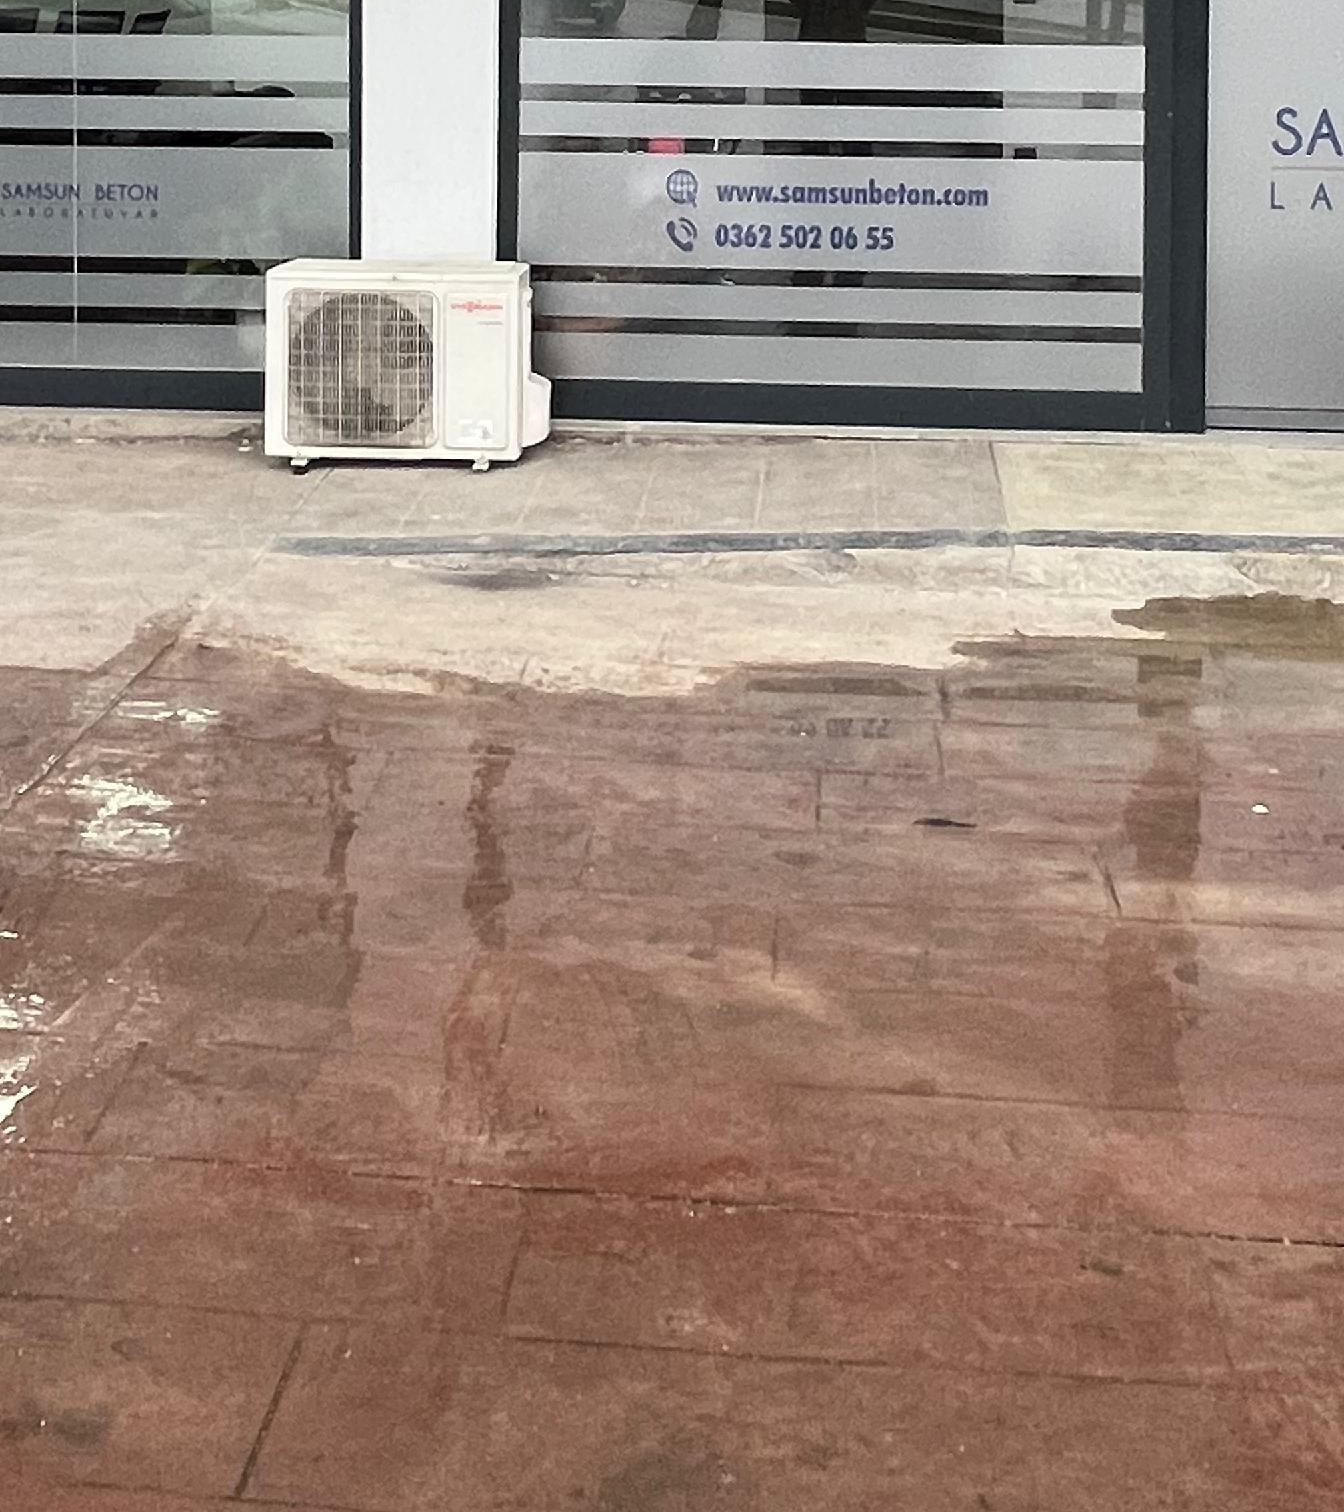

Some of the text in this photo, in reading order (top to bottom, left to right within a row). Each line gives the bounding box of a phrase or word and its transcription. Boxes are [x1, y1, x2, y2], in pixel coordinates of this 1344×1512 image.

[1, 183, 159, 202] SAMSUN BETON
[716, 178, 989, 206] www.samsunbeton.com
[715, 223, 894, 249] 0362 502 06 55
